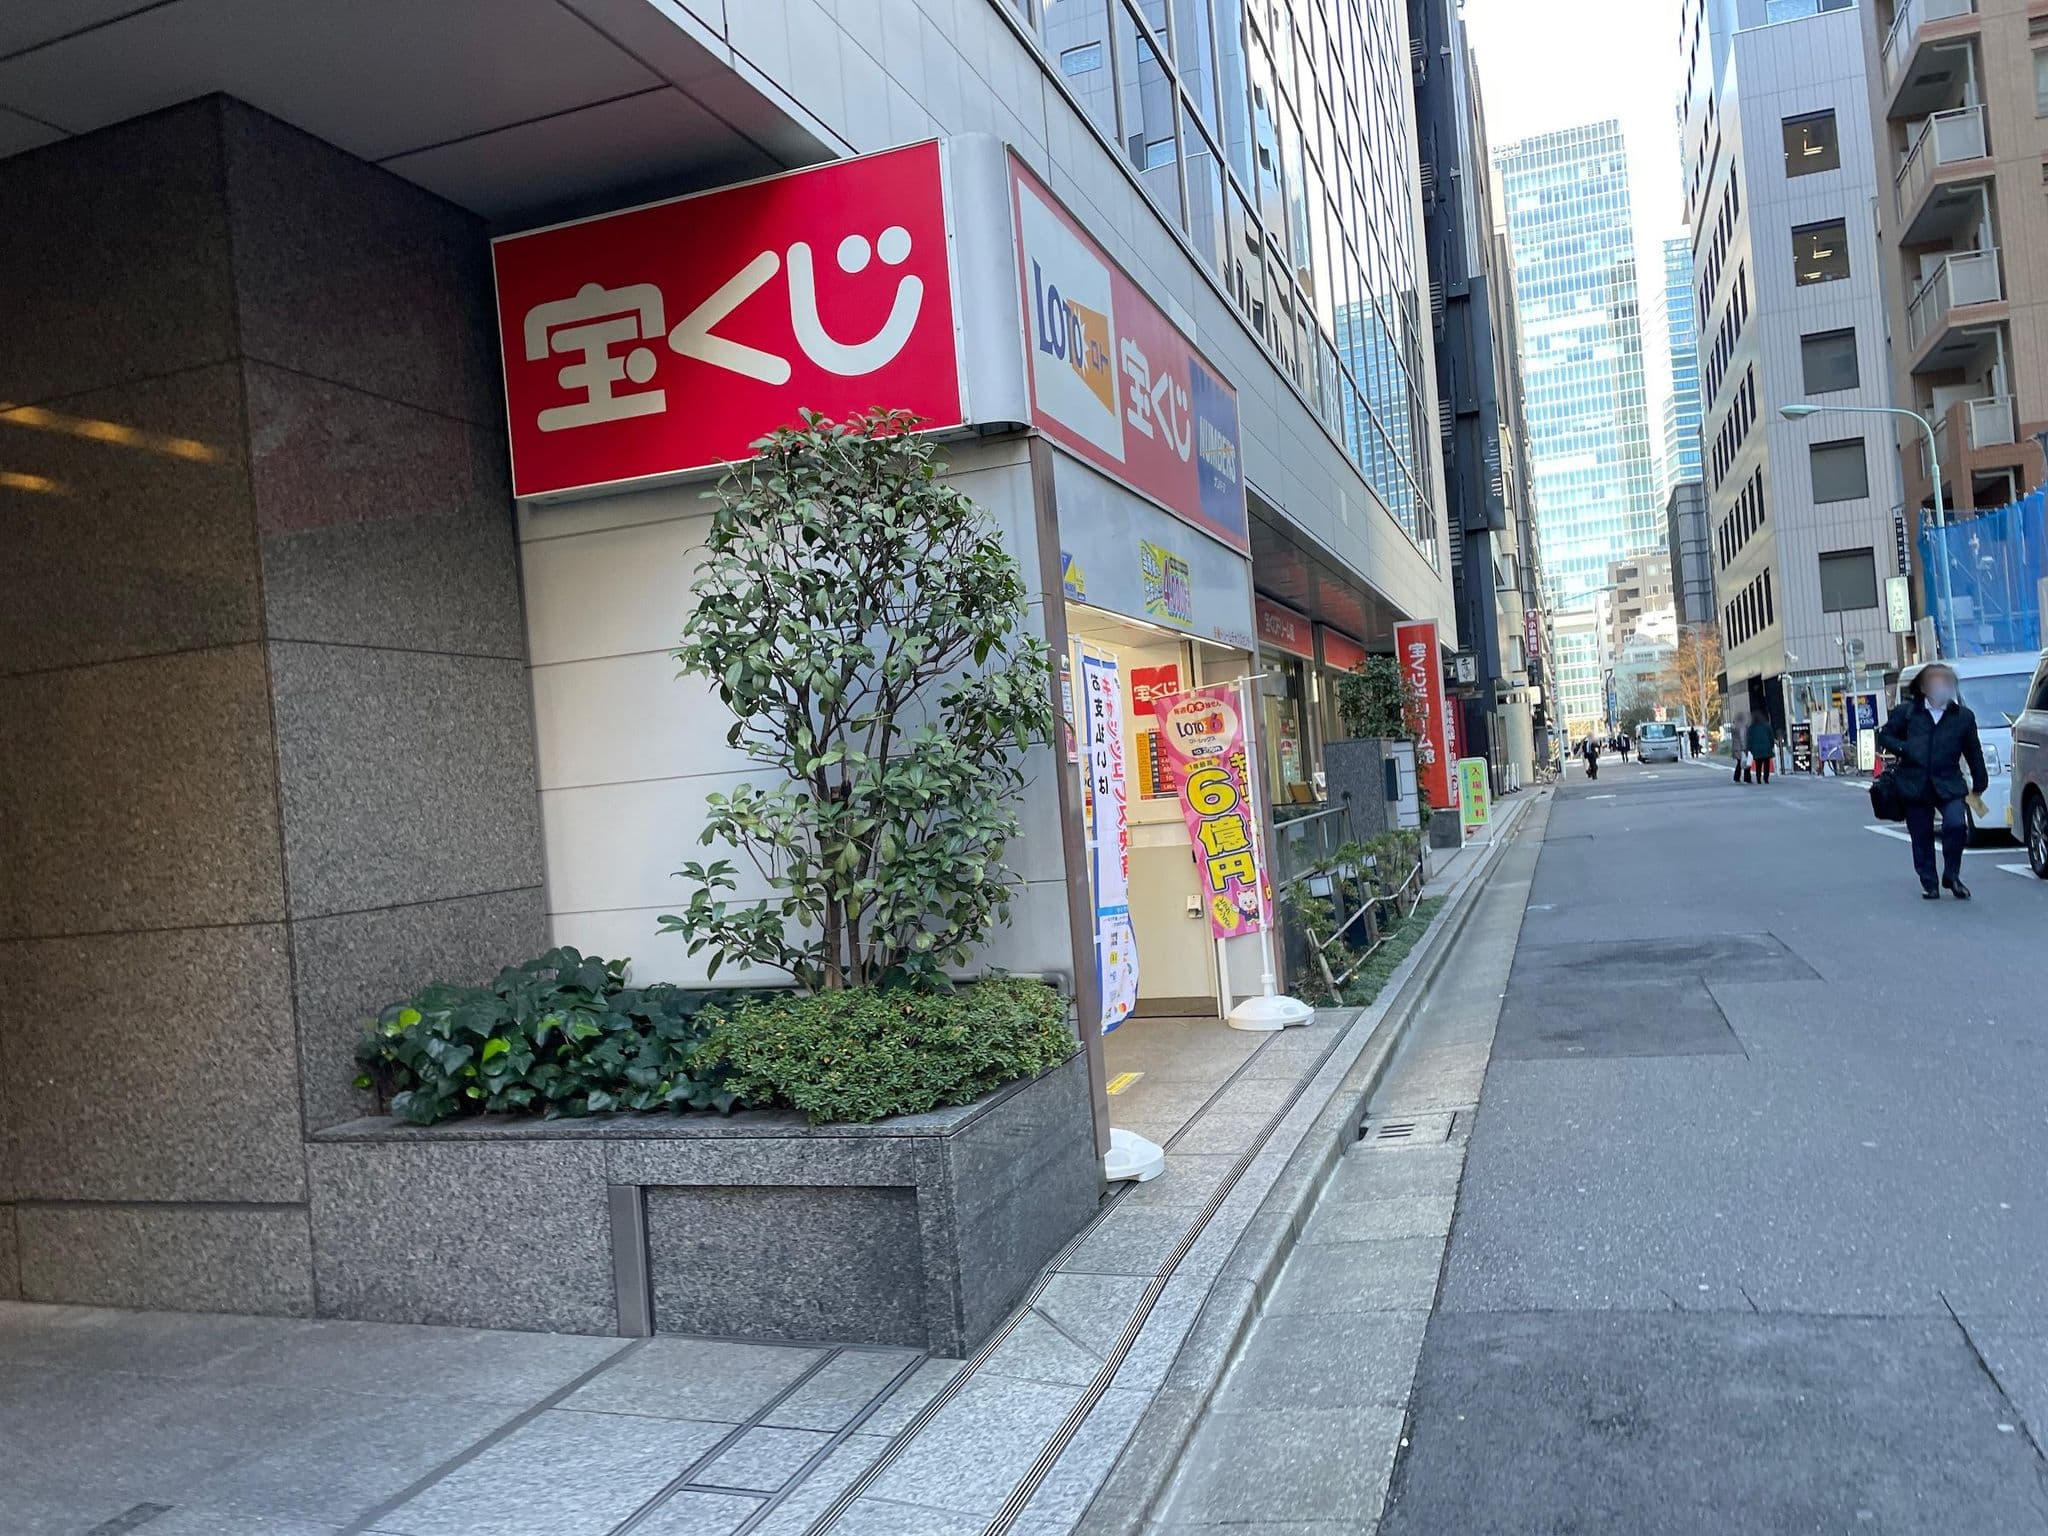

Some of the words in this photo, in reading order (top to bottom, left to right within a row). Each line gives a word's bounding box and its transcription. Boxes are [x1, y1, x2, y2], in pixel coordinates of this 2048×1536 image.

[523, 225, 924, 432] 宝くじ
[1031, 256, 1084, 369] LOTO
[1121, 337, 1191, 463] 宝くじ
[1199, 415, 1236, 484] NUMBERS
[1134, 681, 1178, 701] 宝くじ
[1176, 722, 1204, 738] LOTO
[1211, 712, 1223, 734] 6
